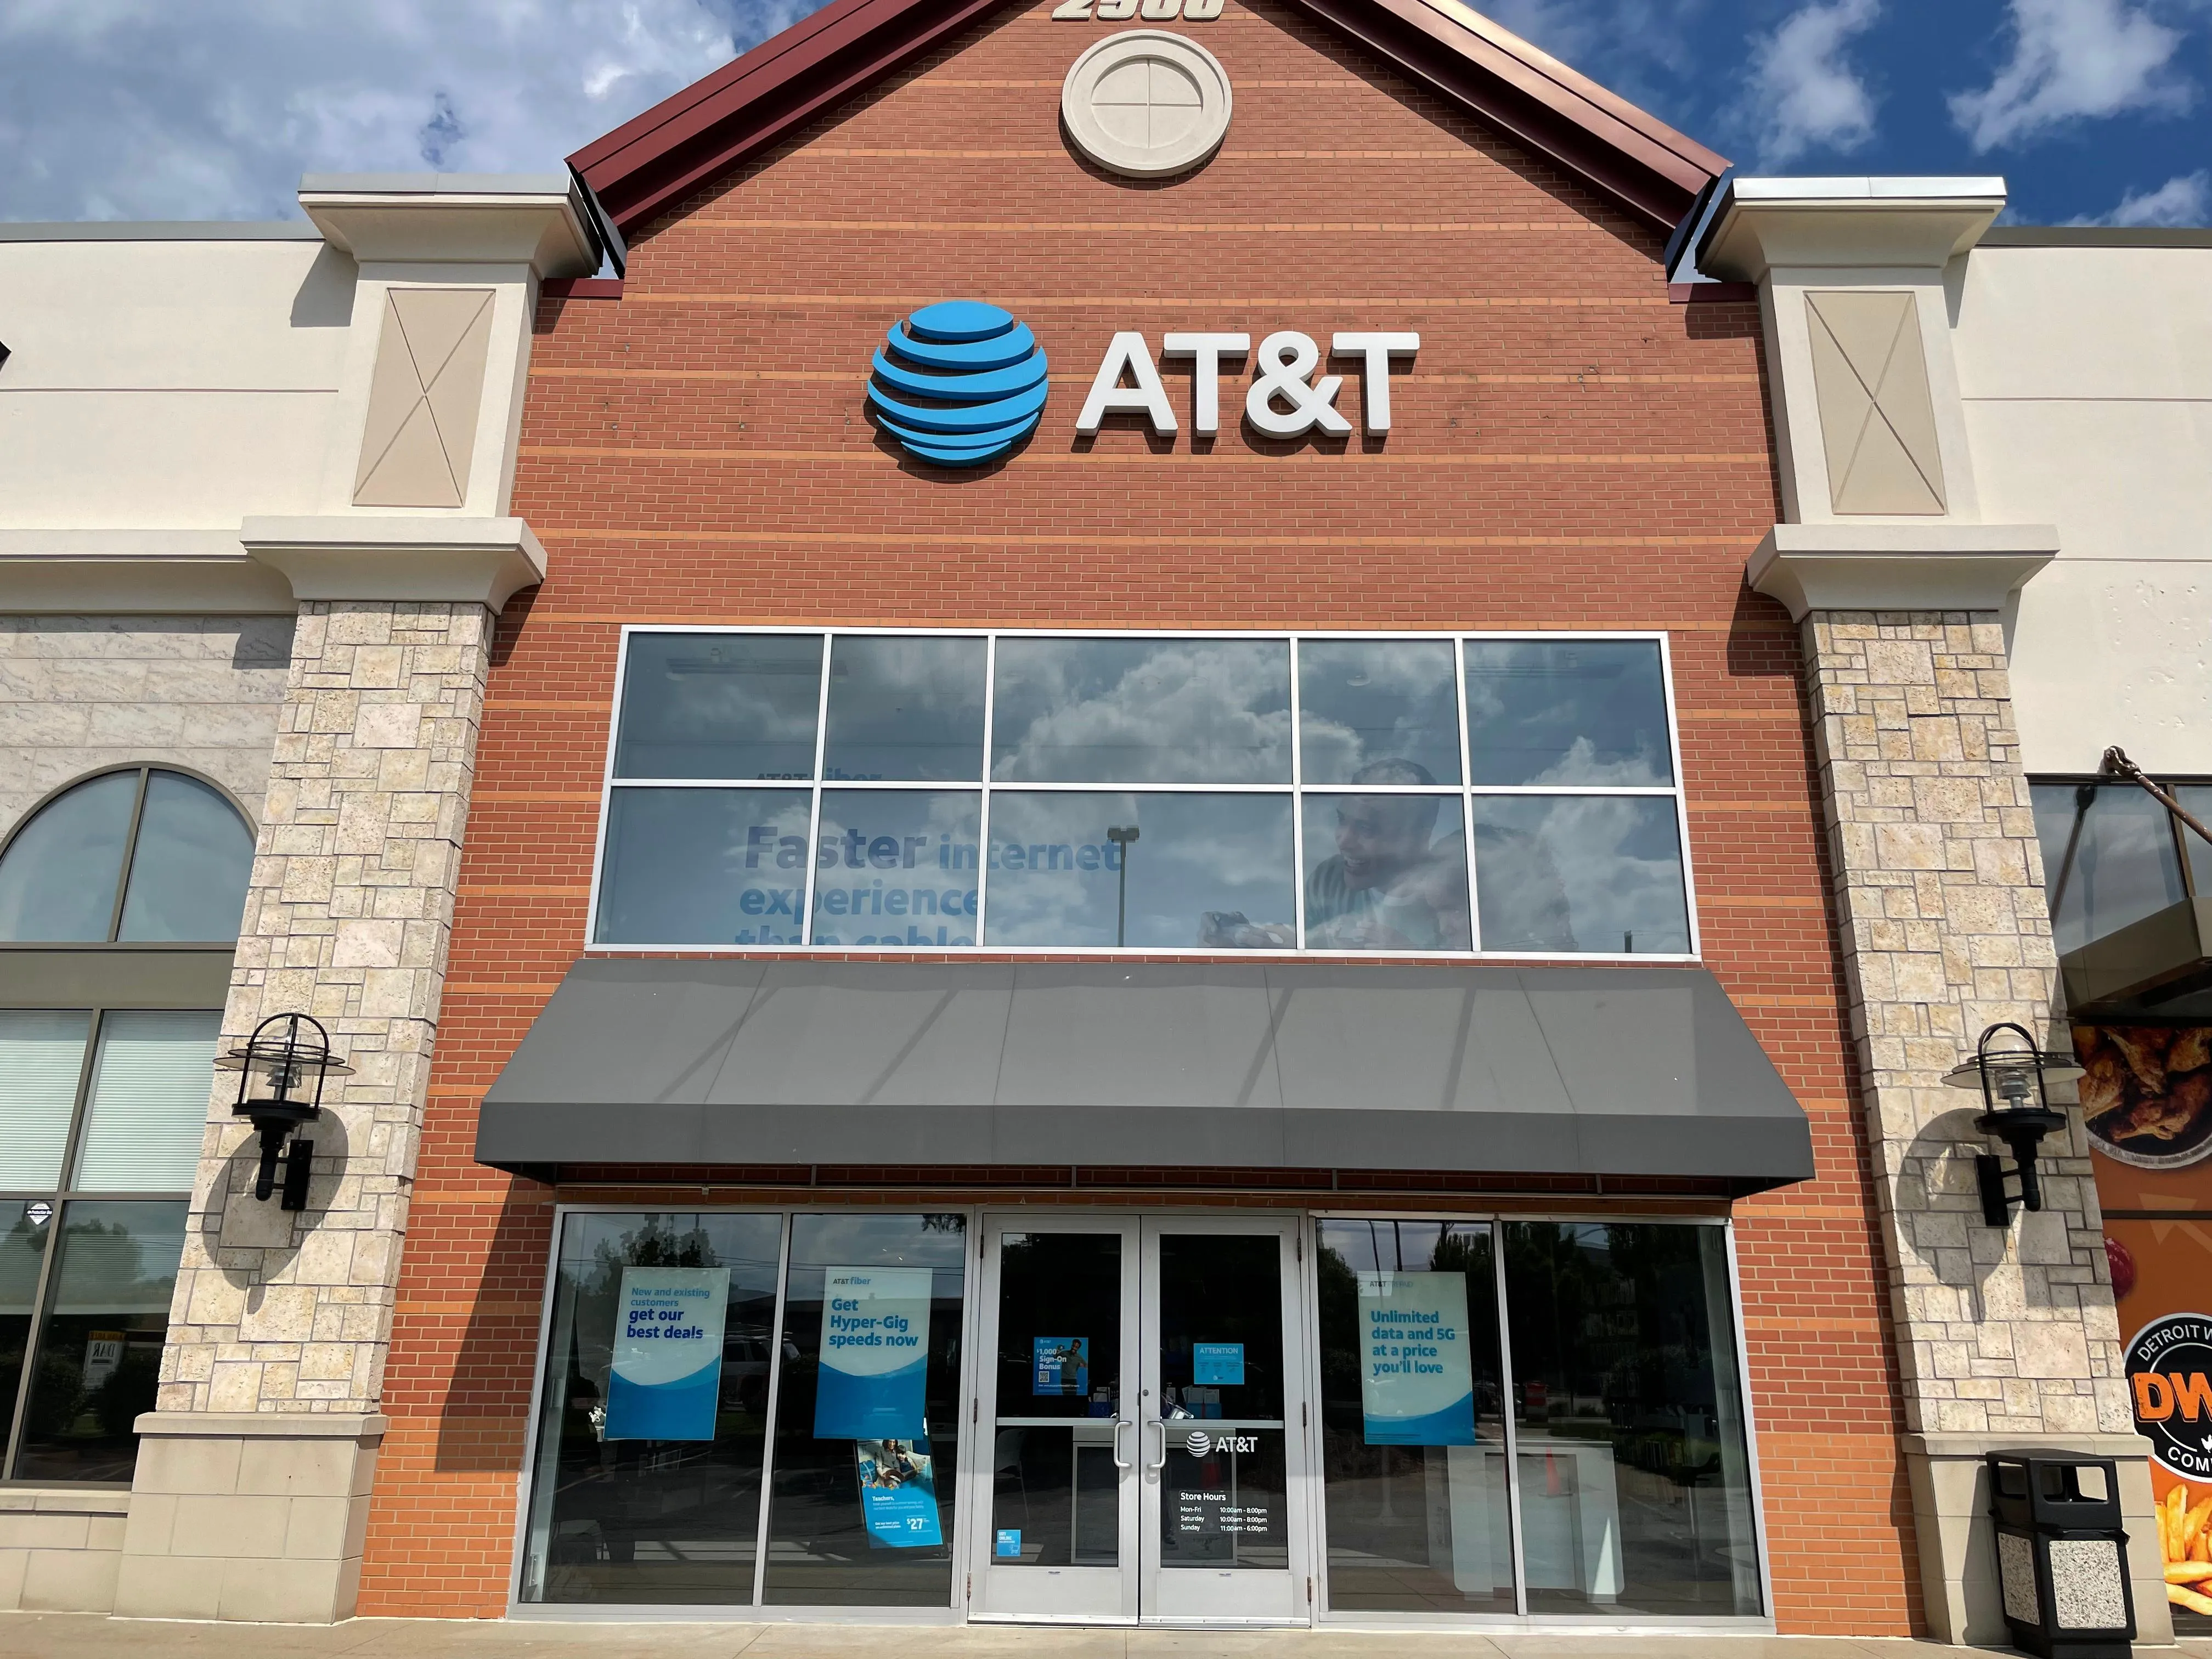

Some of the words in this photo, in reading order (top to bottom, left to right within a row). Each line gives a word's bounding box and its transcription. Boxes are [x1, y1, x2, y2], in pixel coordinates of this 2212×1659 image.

[1076, 331, 1420, 439] AT&T
[745, 826, 927, 868] Faster
[939, 833, 1122, 871] internet
[850, 1277, 871, 1285] fiber
[631, 1288, 652, 1296] New
[654, 1288, 671, 1296] and
[674, 1288, 710, 1299] existing
[631, 1299, 679, 1307] customers
[832, 1298, 859, 1311] Get
[629, 1308, 654, 1324] get
[658, 1311, 684, 1321] our
[830, 1315, 909, 1332] Hyper-Gig
[1370, 1310, 1440, 1323] Unlimited
[627, 1324, 660, 1338] best
[663, 1325, 703, 1339] deals
[1372, 1326, 1403, 1339] data
[1407, 1327, 1433, 1340] and
[1436, 1328, 1455, 1340] 5G
[829, 1332, 882, 1349] speeds
[885, 1335, 919, 1346] now
[2137, 1324, 2200, 1362] DETROIT
[1373, 1344, 1387, 1356] at
[1391, 1346, 1398, 1356] a
[1402, 1344, 1437, 1359] price
[1039, 1356, 1067, 1364] Sign-On
[1373, 1360, 1410, 1376] you'll
[1414, 1360, 1443, 1373] love
[1215, 1436, 1258, 1453] AT&T
[2168, 1446, 2212, 1472] COM
[1180, 1492, 1202, 1500] Store
[1203, 1493, 1226, 1501] Hours
[907, 1518, 923, 1530] $27
